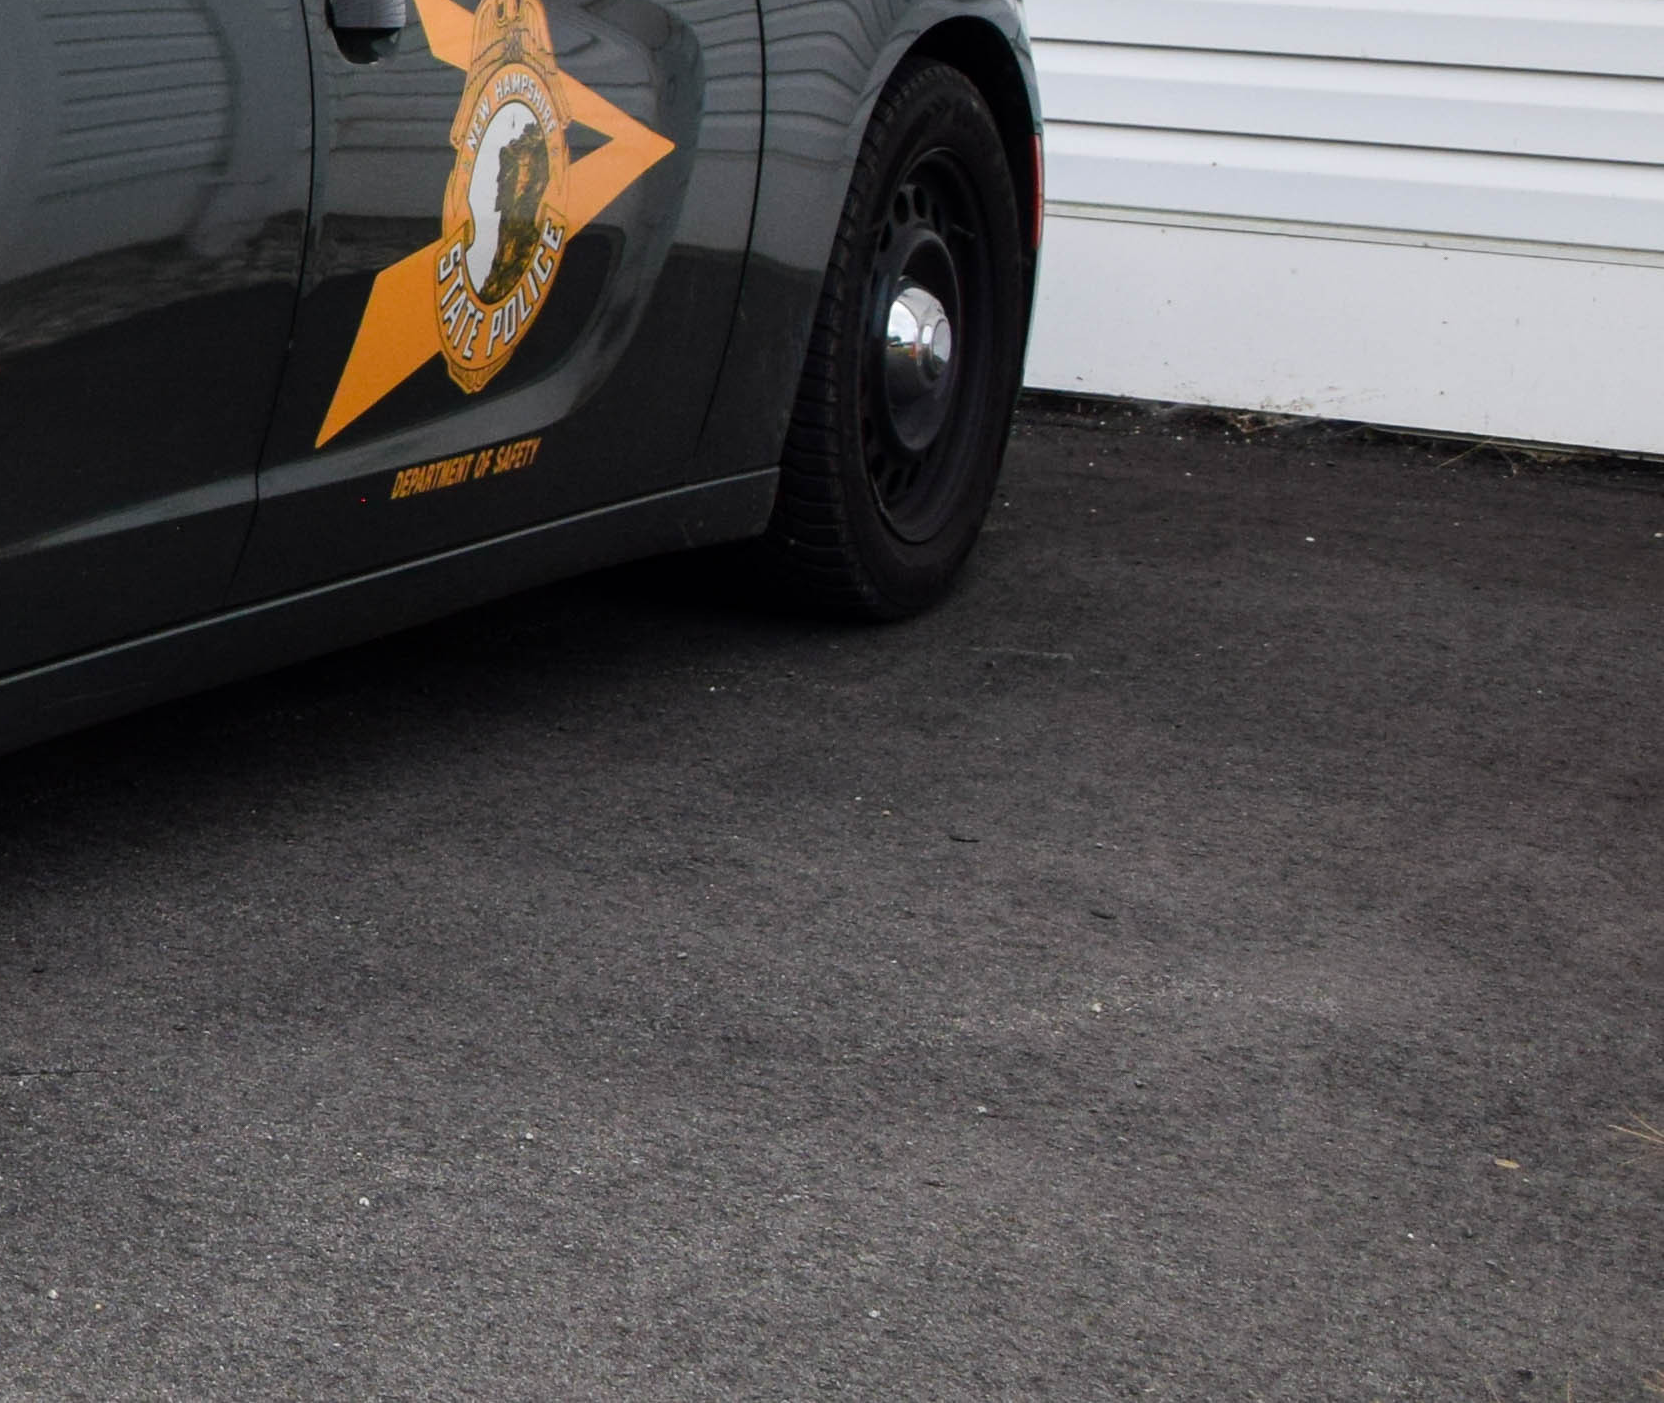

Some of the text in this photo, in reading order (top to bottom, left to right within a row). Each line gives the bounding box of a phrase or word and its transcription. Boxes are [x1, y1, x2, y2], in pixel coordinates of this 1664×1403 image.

[467, 72, 558, 151] NEW HAMPSHIRE
[438, 218, 566, 359] STATE POLICE
[390, 437, 542, 500] DEPARTMENT OF SAFETY
